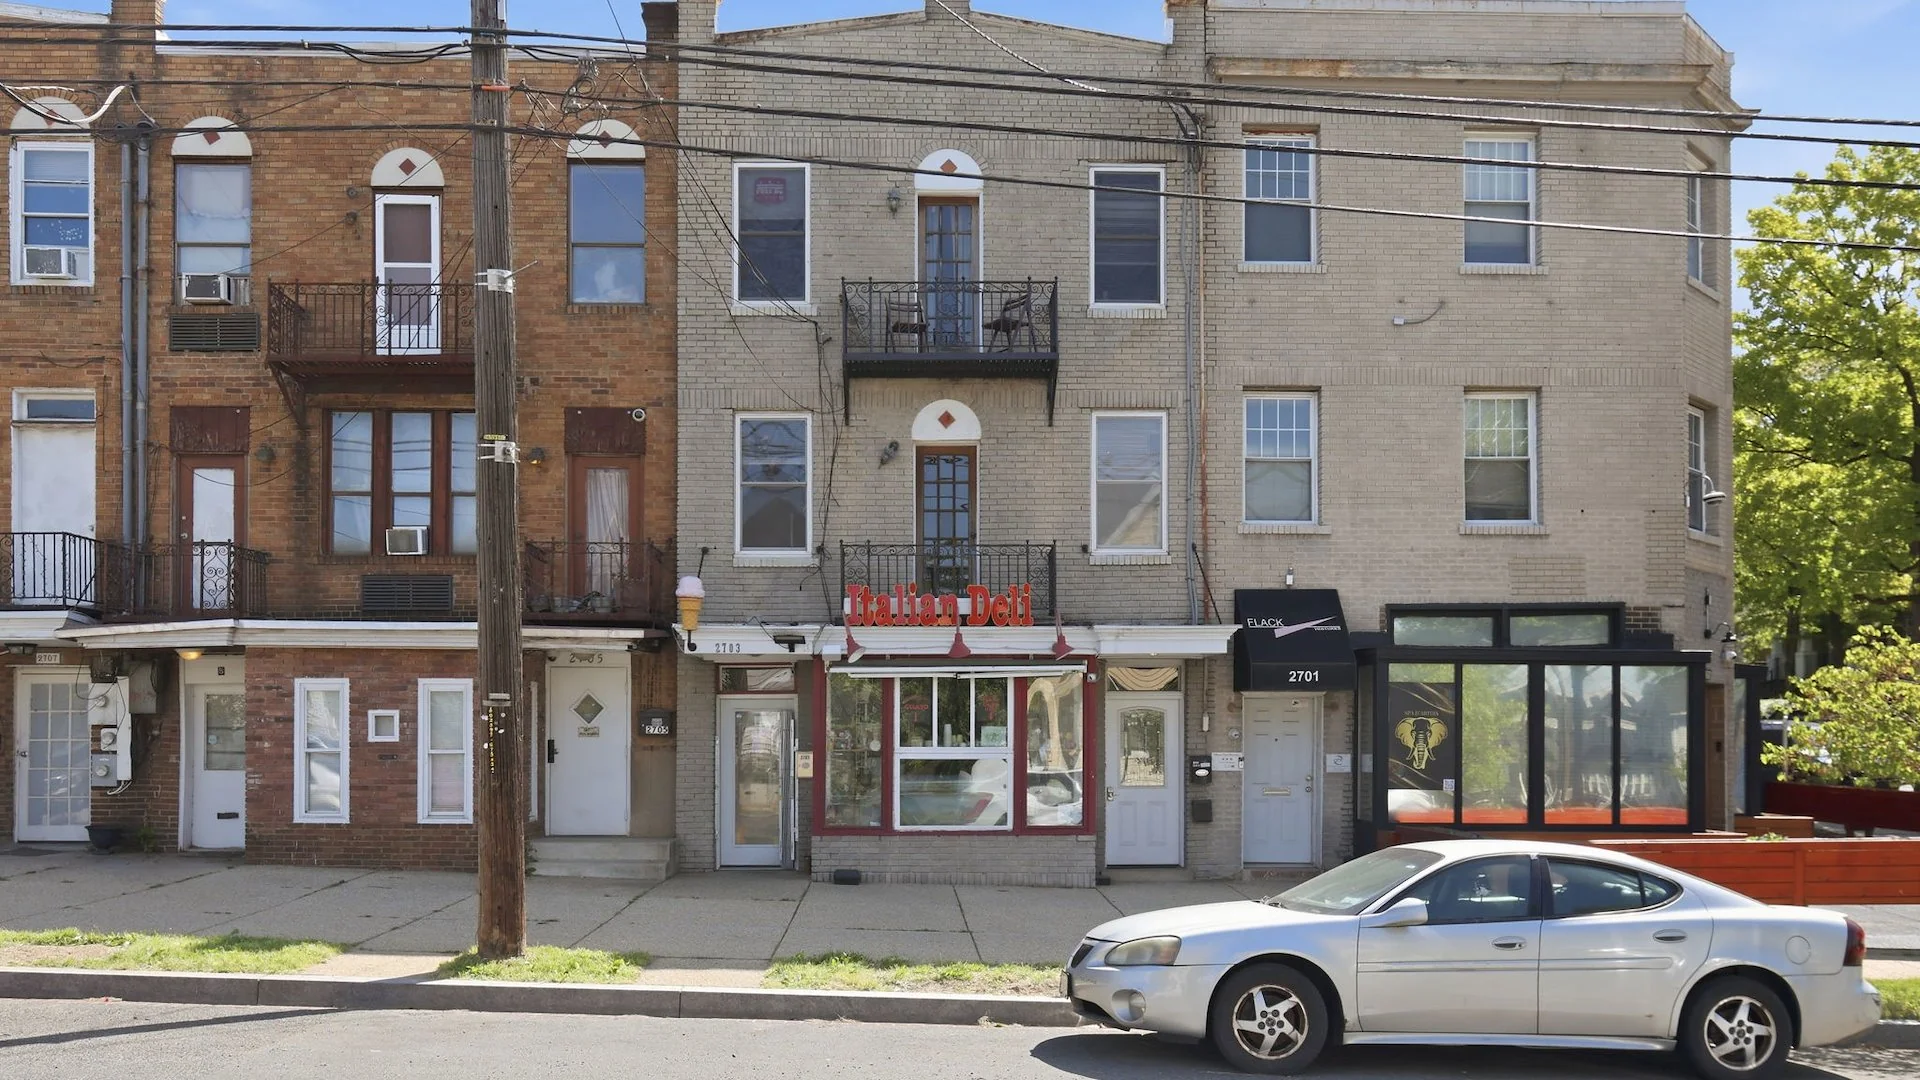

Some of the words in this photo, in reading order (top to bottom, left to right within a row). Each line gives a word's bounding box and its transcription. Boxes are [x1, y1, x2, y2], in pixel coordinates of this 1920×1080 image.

[846, 582, 961, 626] Italian
[967, 582, 1033, 626] Deli
[1246, 617, 1284, 627] FLACK
[715, 642, 741, 653] 2703
[37, 654, 58, 662] 2707
[1288, 670, 1320, 682] 2701
[646, 725, 669, 735] 2705
